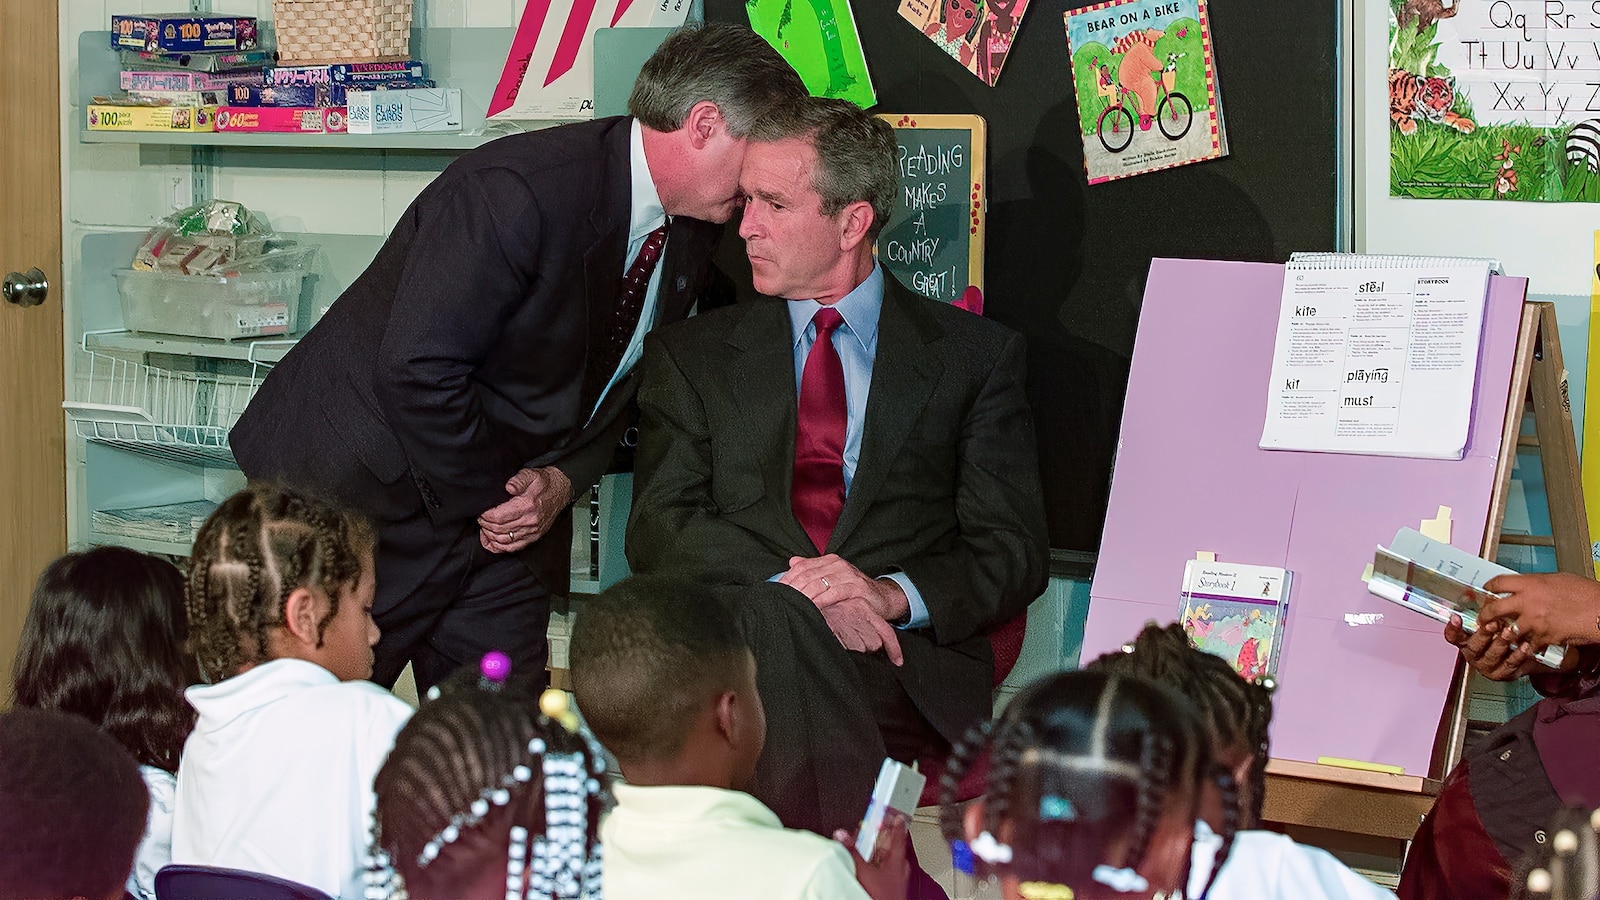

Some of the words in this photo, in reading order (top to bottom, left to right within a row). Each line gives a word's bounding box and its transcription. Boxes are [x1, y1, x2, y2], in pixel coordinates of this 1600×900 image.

[1087, 16, 1116, 33] BEAR
[1120, 12, 1138, 24] ON
[1143, 10, 1151, 20] A
[1155, 2, 1180, 18] BIKE
[1489, 0, 1532, 41] Qq
[1545, 0, 1576, 29] Rr
[179, 22, 201, 39] 100
[1460, 41, 1488, 69] Tt
[1502, 41, 1534, 69] Uu
[1545, 41, 1578, 69] Vv
[229, 86, 248, 100] 100
[375, 103, 403, 113] FLASH
[1493, 82, 1526, 110] Xx
[1538, 82, 1570, 125] Yy
[99, 112, 118, 126] 100
[228, 112, 245, 128] 60
[375, 112, 403, 122] CARDS
[904, 182, 947, 211] MAKES
[913, 212, 927, 236] A
[887, 237, 940, 267] COUNTRY
[1294, 305, 1318, 317] kite
[1285, 378, 1301, 390] kit
[1344, 395, 1375, 406] must
[1197, 576, 1230, 590] Storybook
[1230, 581, 1237, 591] 1
